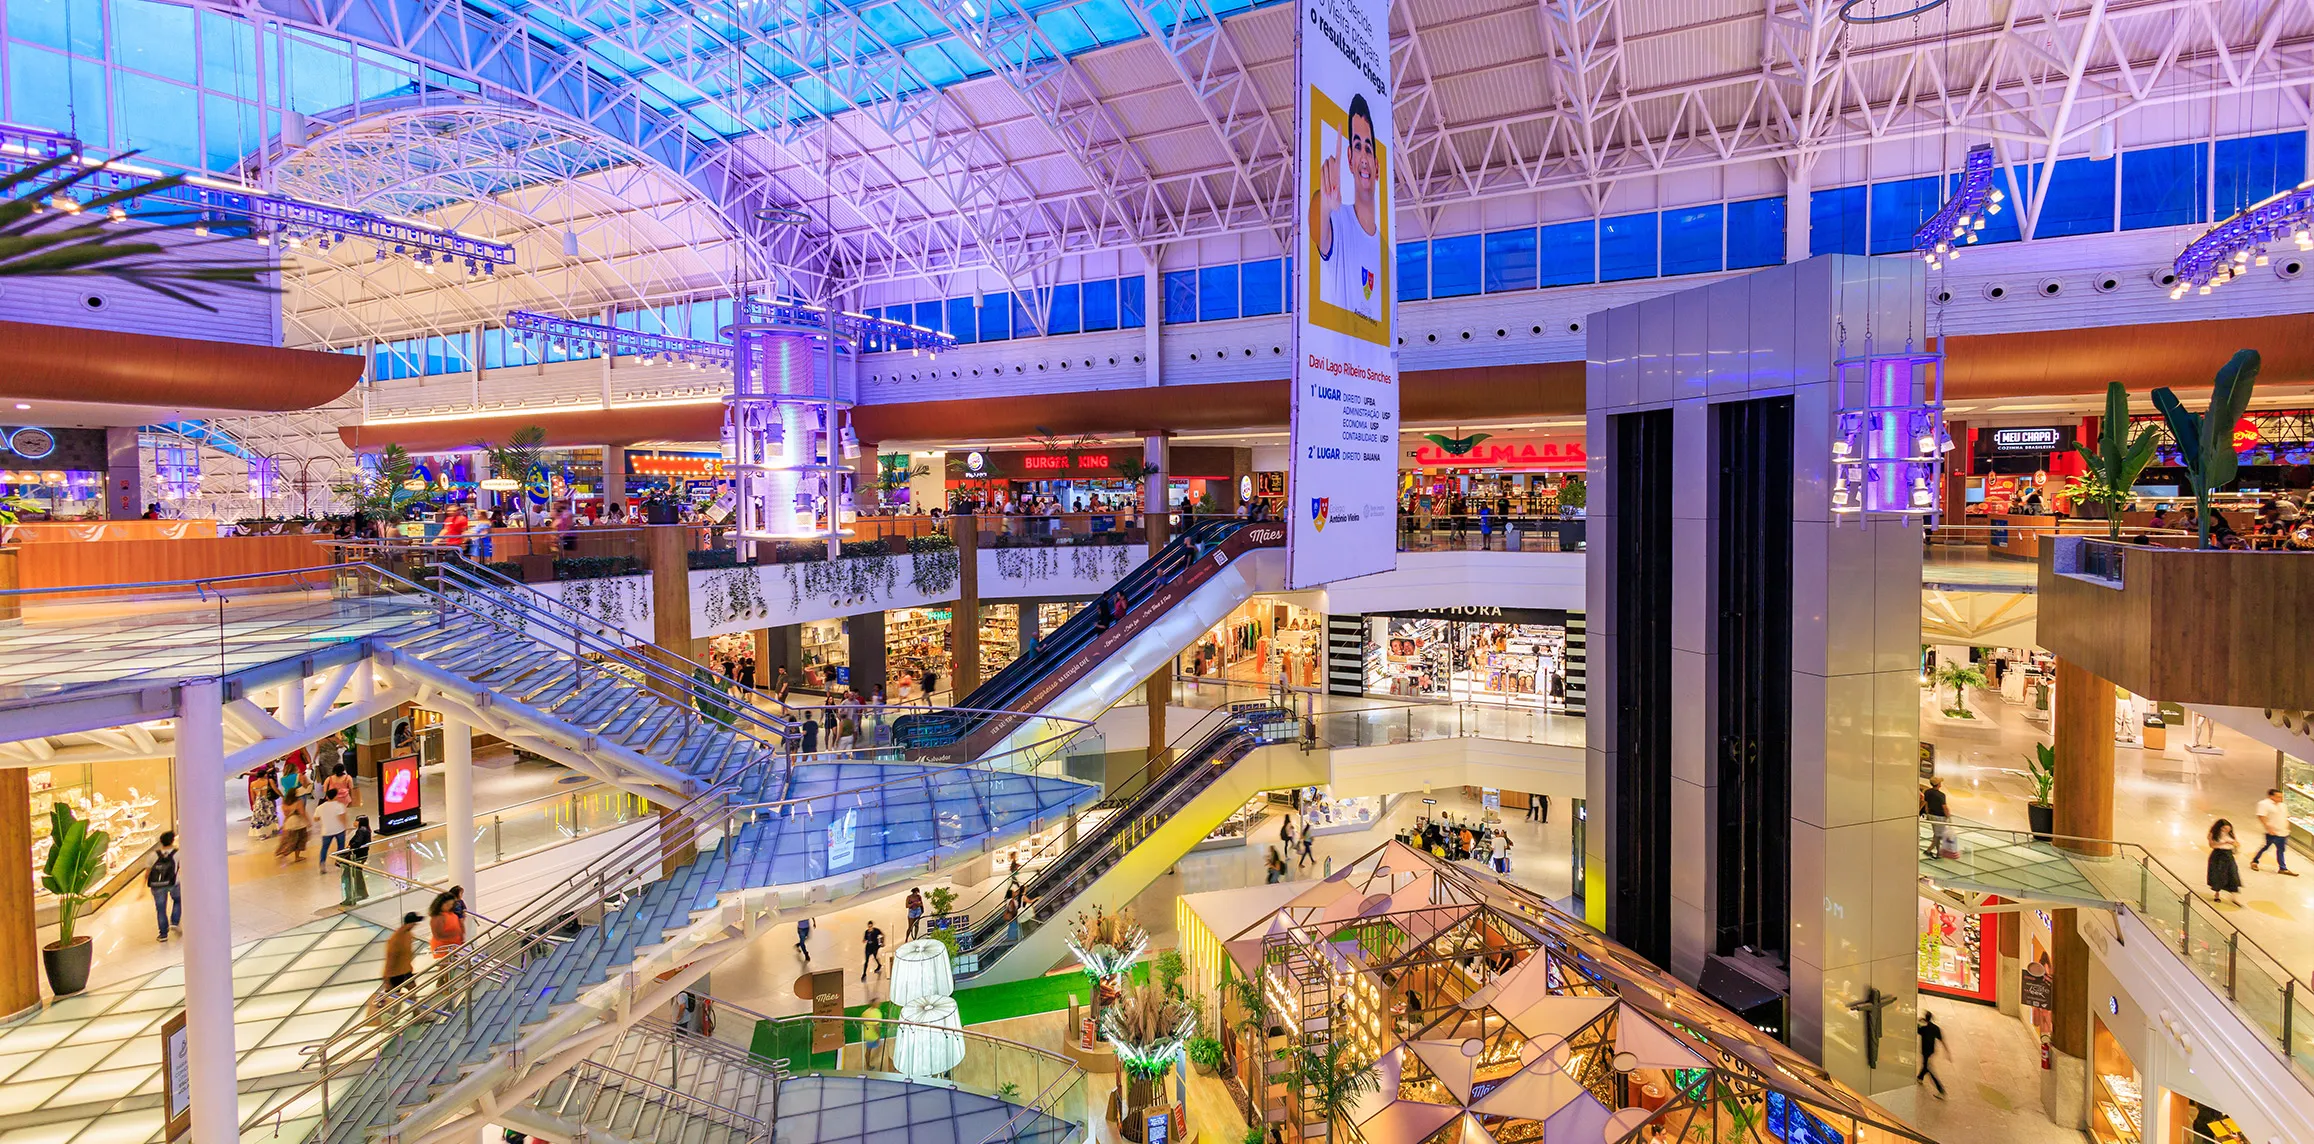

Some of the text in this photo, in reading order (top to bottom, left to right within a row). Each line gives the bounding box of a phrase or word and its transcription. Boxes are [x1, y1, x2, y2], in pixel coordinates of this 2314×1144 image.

[1310, 8, 1388, 98] o resultado chega.
[1309, 354, 1392, 385] Davi Lago Ribeiro Sanches
[1318, 385, 1342, 401] LUGAR
[1343, 392, 1361, 404] DIREITO
[1363, 396, 1376, 406] UFBA
[1342, 405, 1391, 420] ADMINISTRAÇÃO USP
[1342, 418, 1380, 431] ECONOMIA USP
[1342, 431, 1389, 443] CONTABILIDADE USP
[2002, 431, 2050, 442] MEU CHAPA
[1316, 446, 1341, 460] LUGAR
[1342, 451, 1361, 461] DIREITO
[1363, 452, 1381, 462] BAIANA
[1416, 443, 1586, 465] CIEMARK
[1024, 455, 1109, 469] BURGER KING
[1249, 528, 1283, 544] Mães
[815, 992, 840, 1003] Mães
